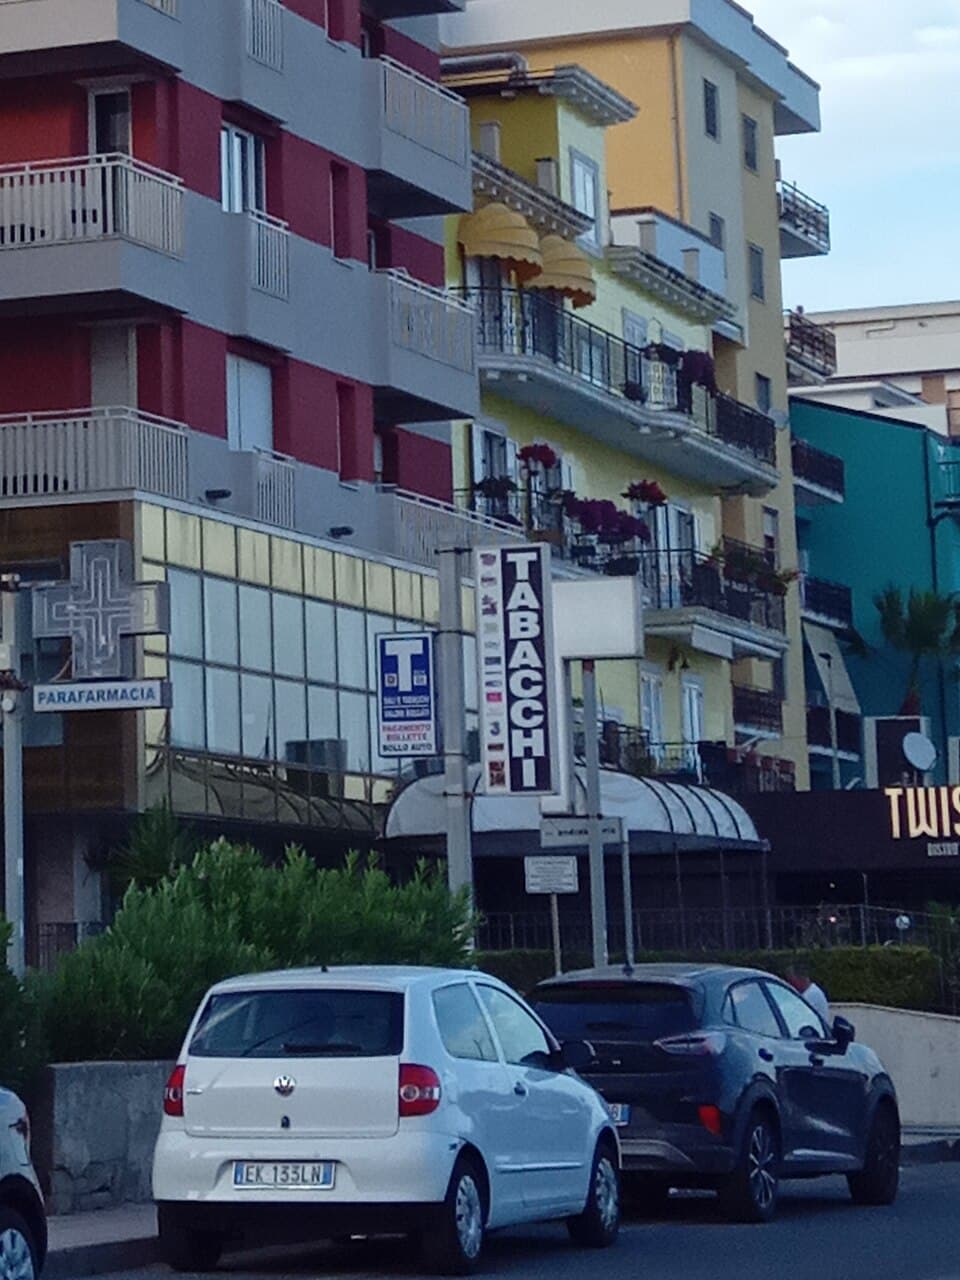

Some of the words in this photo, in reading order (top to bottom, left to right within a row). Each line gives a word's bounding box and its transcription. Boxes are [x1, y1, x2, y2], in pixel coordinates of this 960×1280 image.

[385, 640, 423, 691] T
[506, 551, 545, 788] TABACCHI
[38, 687, 155, 704] PARAFARMACIA
[246, 1166, 262, 1182] EK
